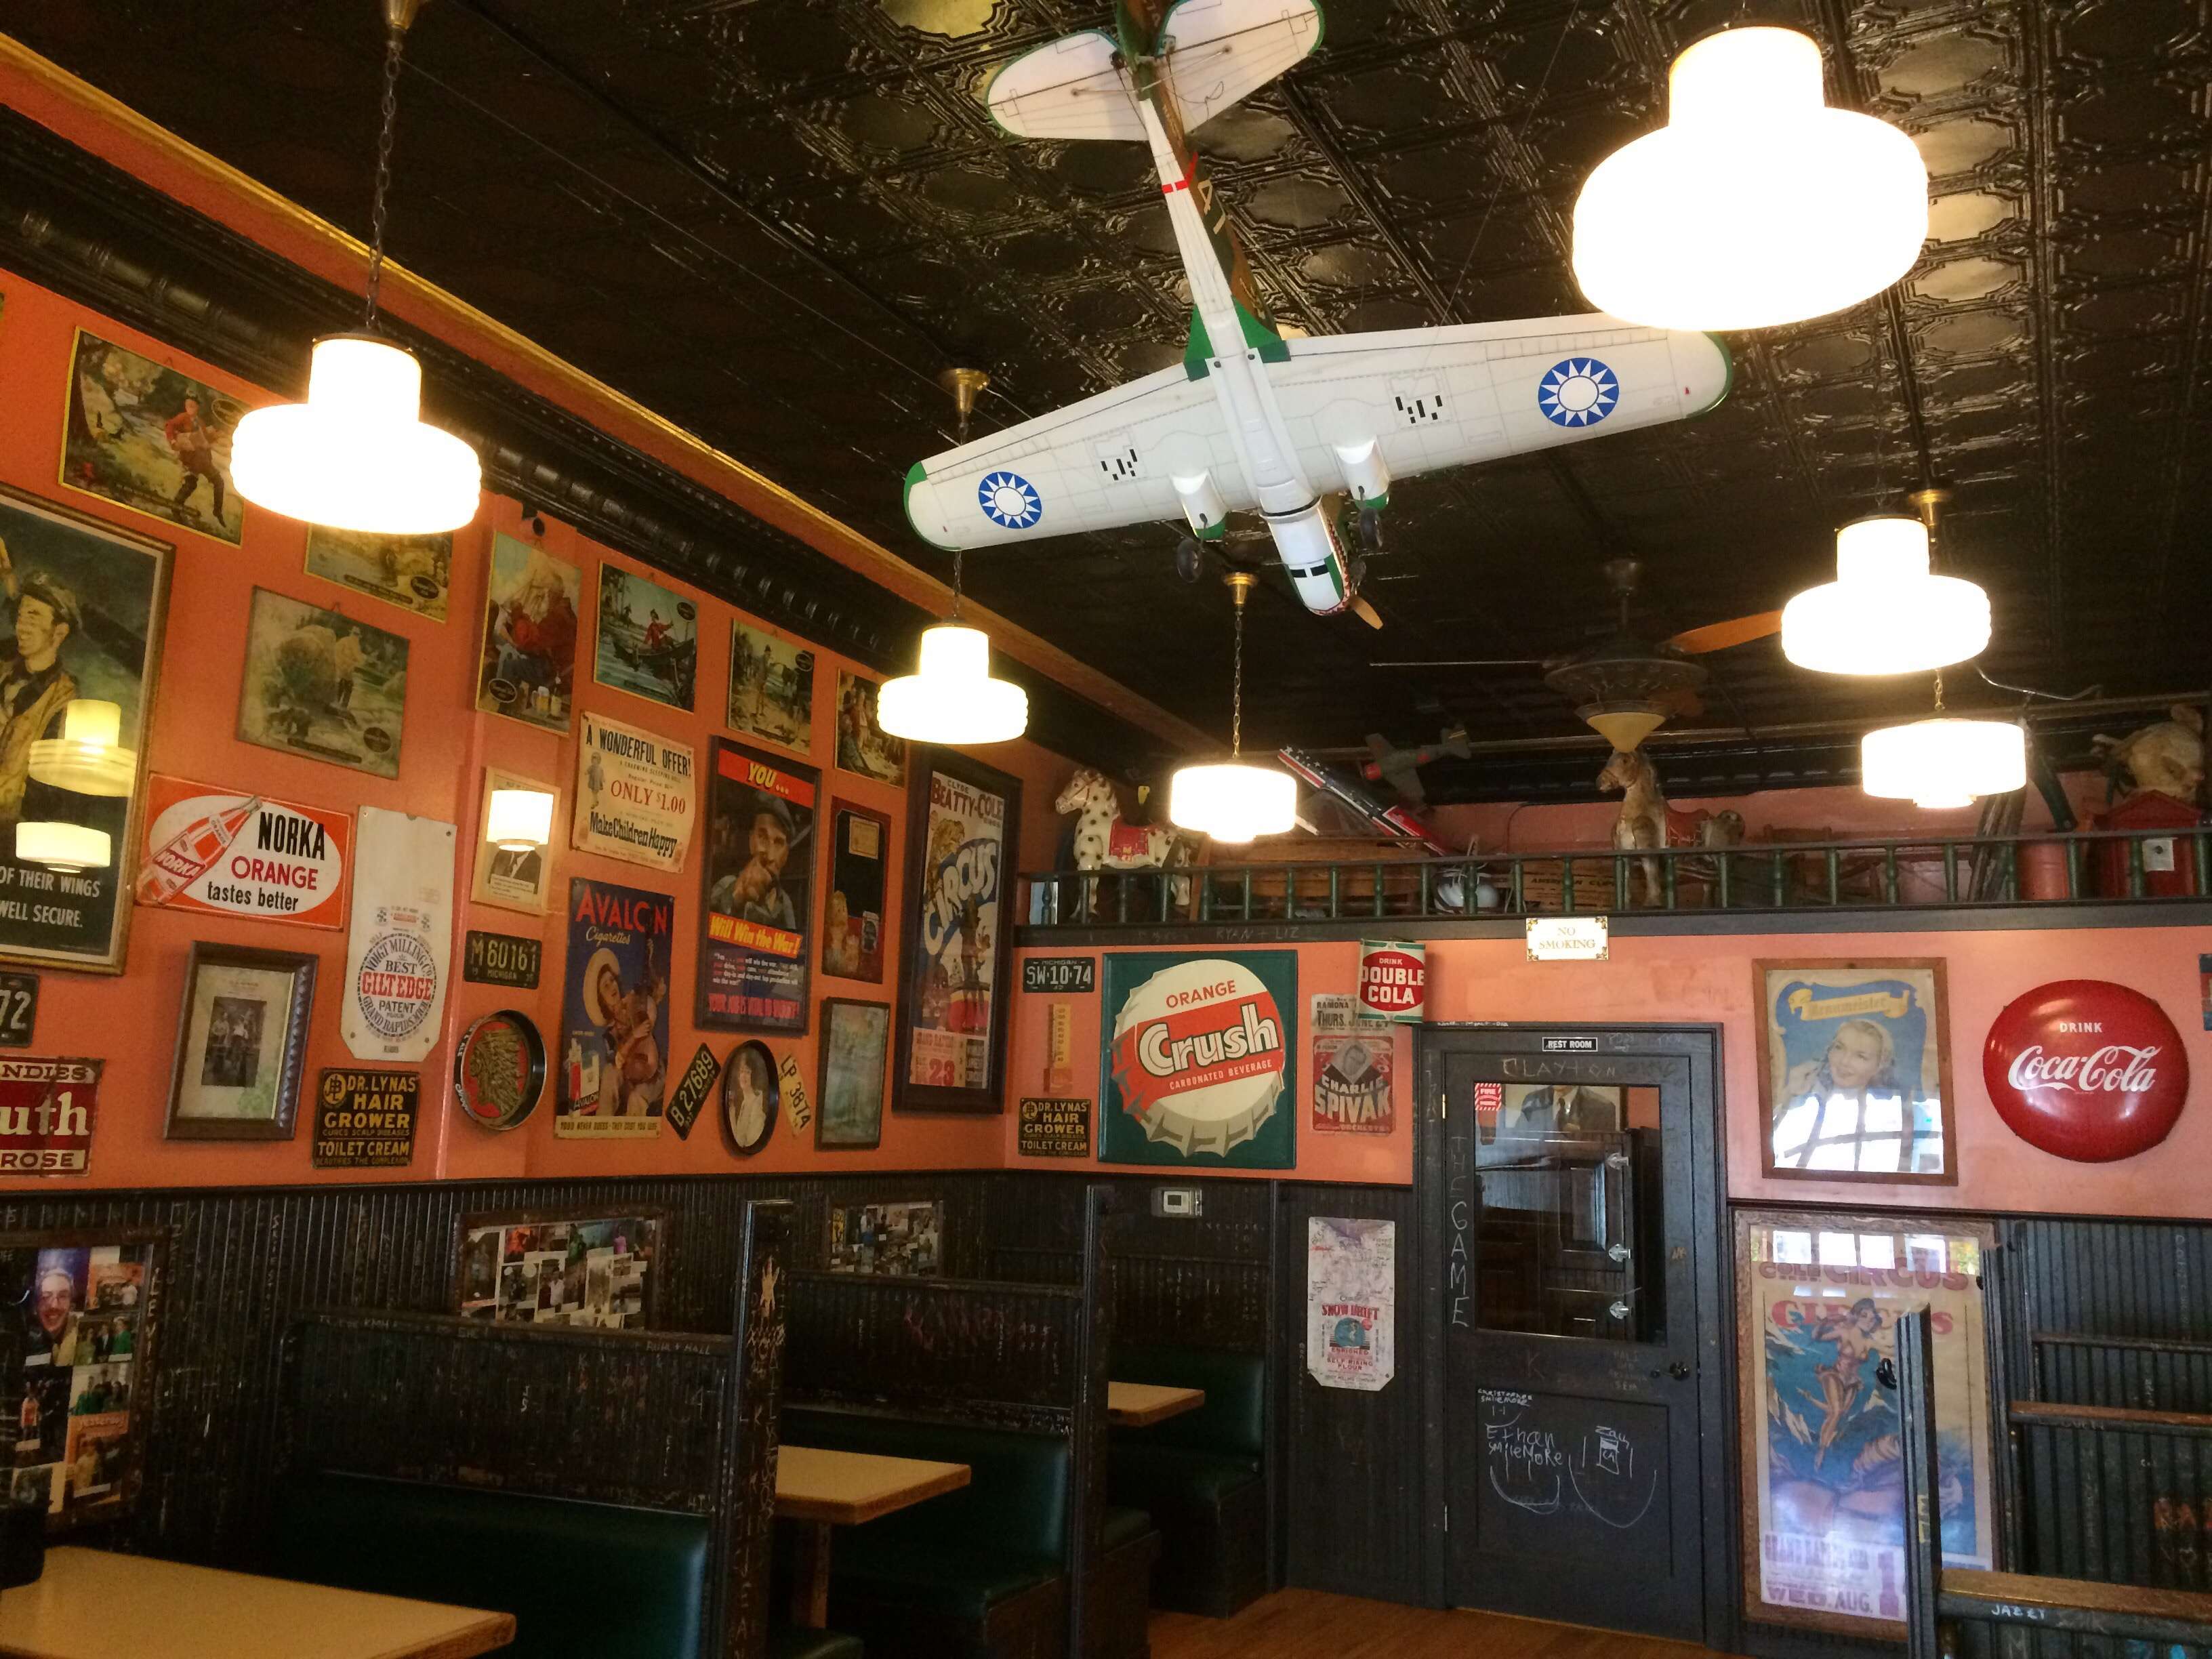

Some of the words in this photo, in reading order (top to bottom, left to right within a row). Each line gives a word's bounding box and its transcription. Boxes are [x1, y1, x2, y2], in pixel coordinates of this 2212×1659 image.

[586, 724, 593, 746] A
[599, 727, 657, 766] WONDERFUL
[661, 748, 692, 777] OFFER!
[611, 780, 654, 806] ONLY
[656, 792, 686, 814] $1.00
[947, 779, 970, 794] CLYDE
[258, 811, 325, 861] NORKA
[590, 811, 613, 836] Make
[613, 817, 649, 848] Children
[649, 827, 678, 859] Happy
[155, 850, 201, 877] NORKA
[231, 855, 319, 890] ORANGE
[0, 865, 15, 884] OF
[19, 869, 55, 891] THEIR
[60, 875, 101, 898] WINGS
[207, 881, 251, 905] tastes
[258, 888, 299, 912] better
[923, 842, 997, 956] CIRCUS
[0, 900, 28, 921] WELL
[33, 904, 83, 928] SECURE.
[586, 926, 631, 947] Cigarettes
[710, 915, 734, 939] Will
[734, 920, 754, 944] Win
[756, 928, 773, 948] the
[1275, 926, 1299, 939] LIZ
[1557, 926, 1576, 937] NO
[365, 942, 389, 970] VOIGT
[389, 938, 428, 966] MILLING
[1539, 939, 1596, 949] SMOKING
[385, 960, 417, 975] BEST
[1379, 958, 1403, 966] DRINK
[361, 971, 396, 997] GILT
[396, 975, 434, 1001] EDGE
[1361, 966, 1425, 986] DOUBLE
[1166, 980, 1237, 1008] ORANGE
[1368, 985, 1415, 1004] COLA
[363, 996, 384, 1029] GRAND
[379, 1000, 416, 1014] PATENT
[1317, 1001, 1349, 1010] RAMONA
[1317, 1010, 1347, 1027] THURS.
[2059, 1022, 2103, 1033] DRINK
[1138, 1002, 1280, 1076] Crush
[1547, 1040, 1567, 1049] REST
[1570, 1040, 1592, 1049] ROOM
[1169, 1071, 1224, 1090] CARBONATED
[1228, 1059, 1273, 1077] BEVERAGE
[2008, 1046, 2163, 1092] Coca-Cola
[347, 1075, 369, 1091] DR.
[371, 1076, 417, 1092] LYNAS
[353, 1093, 404, 1110] HAIR
[1038, 1102, 1054, 1112] DR.
[1054, 1102, 1087, 1112] LYNAS
[1314, 1084, 1392, 1124] SPIVAK
[0, 1091, 89, 1136] uth
[324, 1112, 410, 1128] GROWER
[1043, 1112, 1079, 1123] HAIR
[1024, 1124, 1085, 1134] GROWER
[318, 1141, 365, 1156] TOILET
[367, 1141, 409, 1156] CREAM
[1021, 1140, 1053, 1150] TOILET
[1054, 1141, 1087, 1151] CREAM
[1450, 1201, 1470, 1328] GAME
[1322, 1304, 1349, 1316] SNOW
[1351, 1304, 1380, 1321] DRIFT
[1835, 1591, 1874, 1614] AUG.
